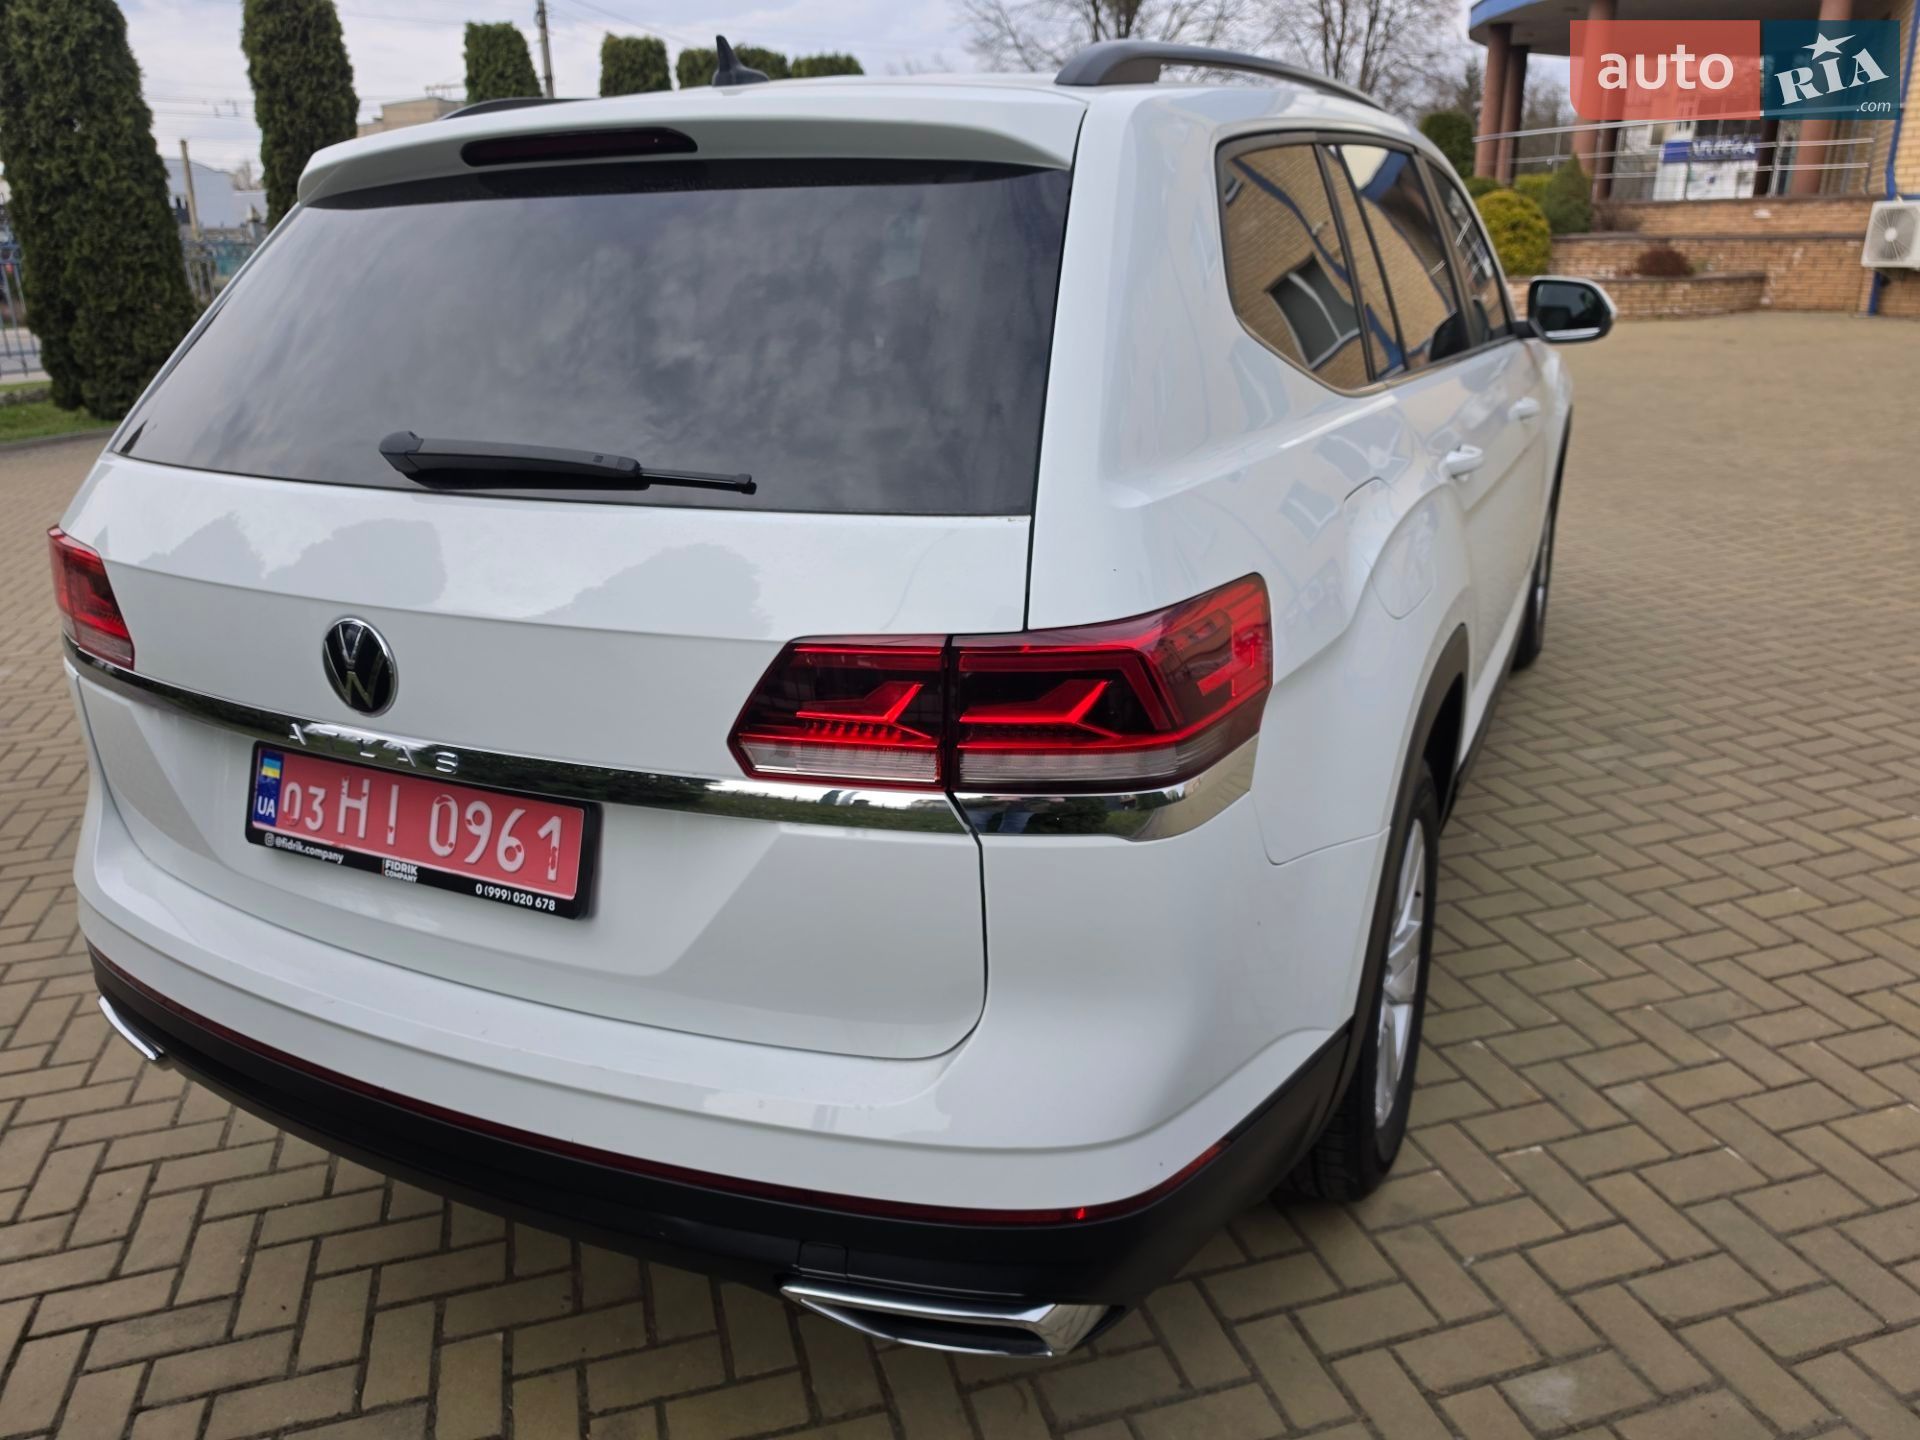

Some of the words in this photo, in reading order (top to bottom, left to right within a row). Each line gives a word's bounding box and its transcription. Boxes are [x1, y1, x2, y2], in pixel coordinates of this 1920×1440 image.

[289, 723, 458, 774] ATLAS
[257, 796, 275, 818] UA
[384, 860, 417, 875] FIDRIK
[484, 886, 511, 901] (999)
[513, 892, 533, 906] 020
[535, 898, 556, 911] 678
